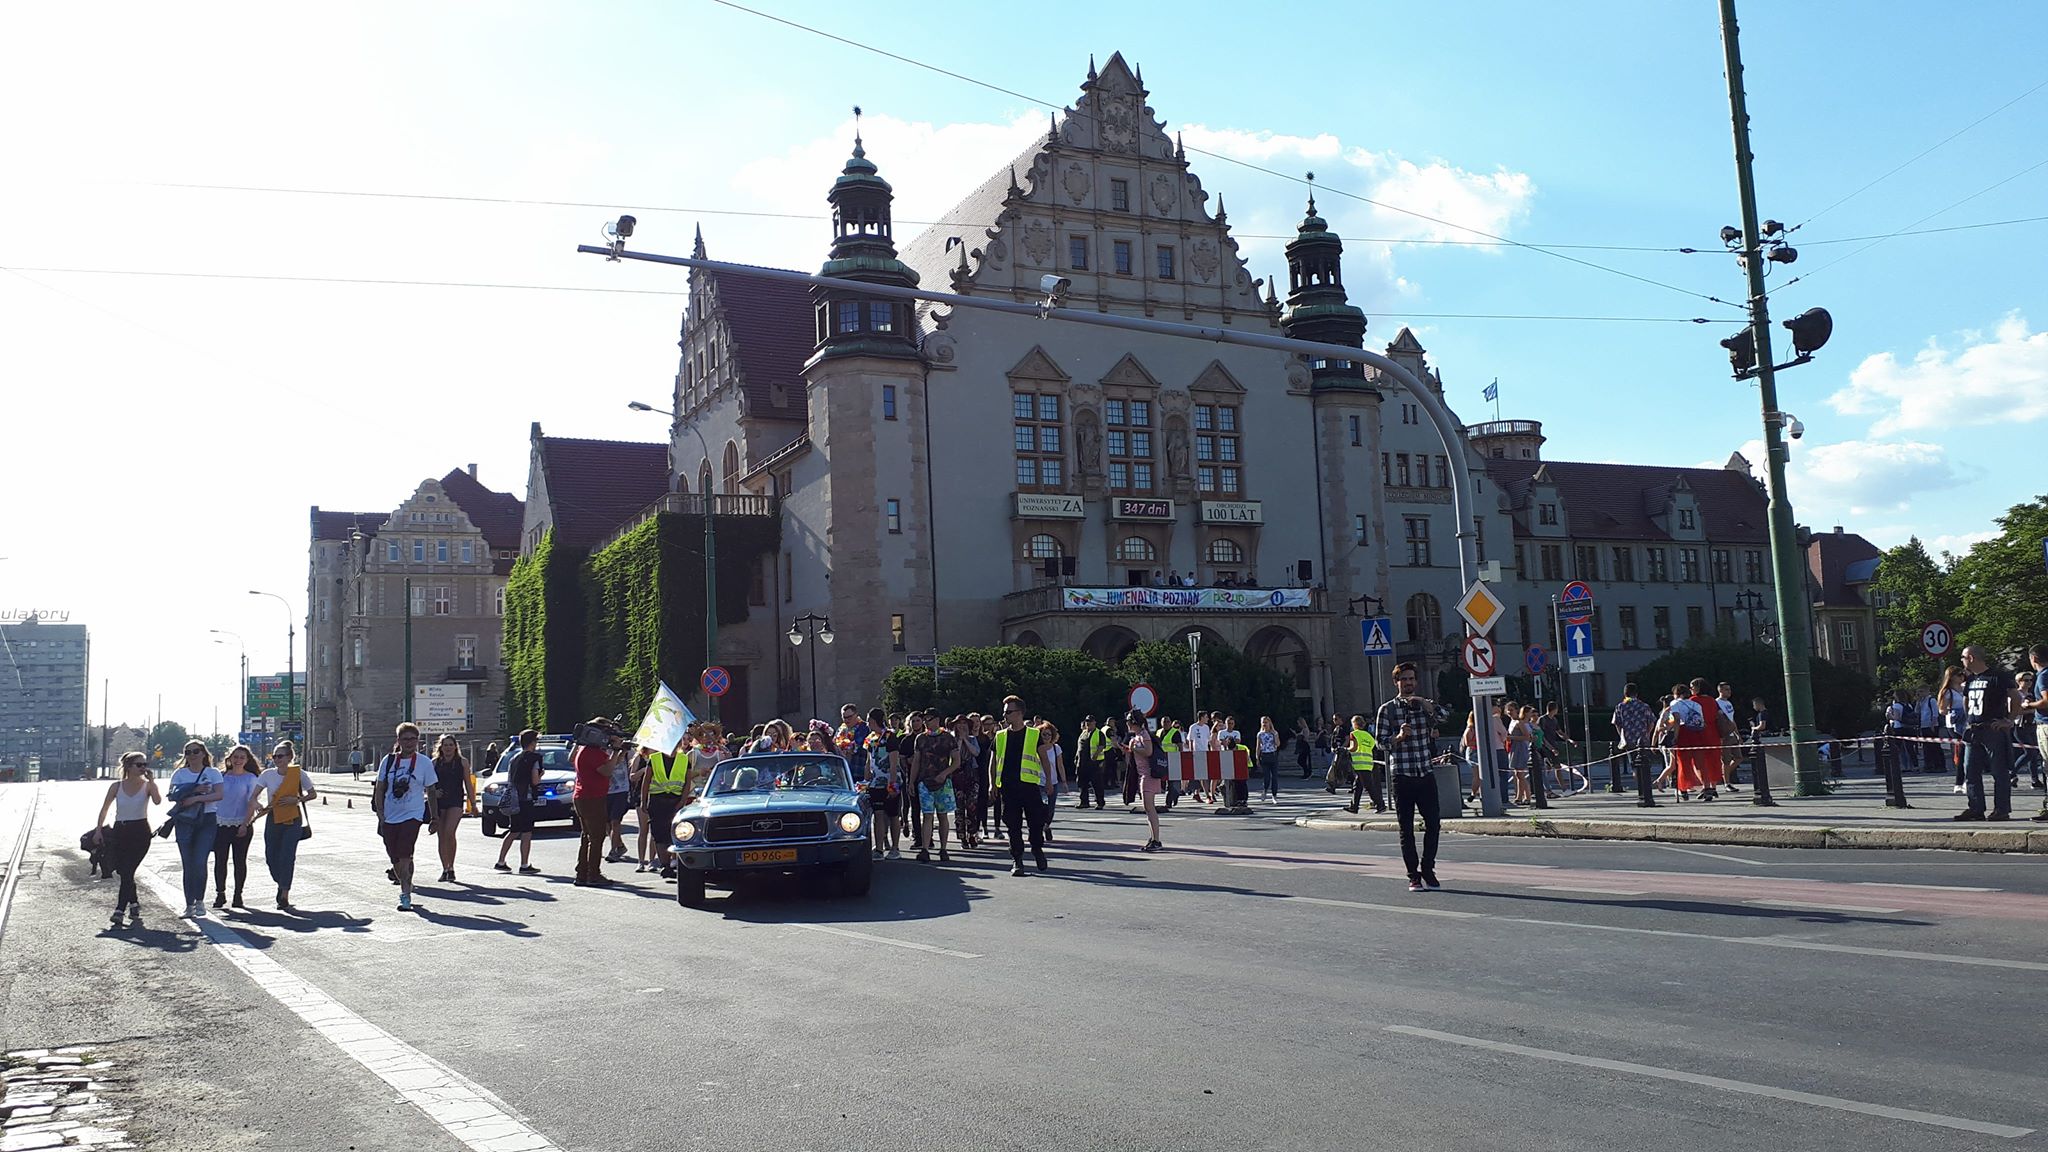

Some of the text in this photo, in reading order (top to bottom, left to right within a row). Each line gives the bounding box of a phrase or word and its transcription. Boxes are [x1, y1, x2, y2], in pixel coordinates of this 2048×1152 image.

[1019, 497, 1083, 513] UNIWERSYTET ZA
[1123, 502, 1167, 516] 347 dni
[1207, 508, 1257, 521] 100 LAT
[1105, 591, 1159, 605] JUWENALIA
[1925, 629, 1948, 648] 30
[743, 850, 782, 862] PO 96G
